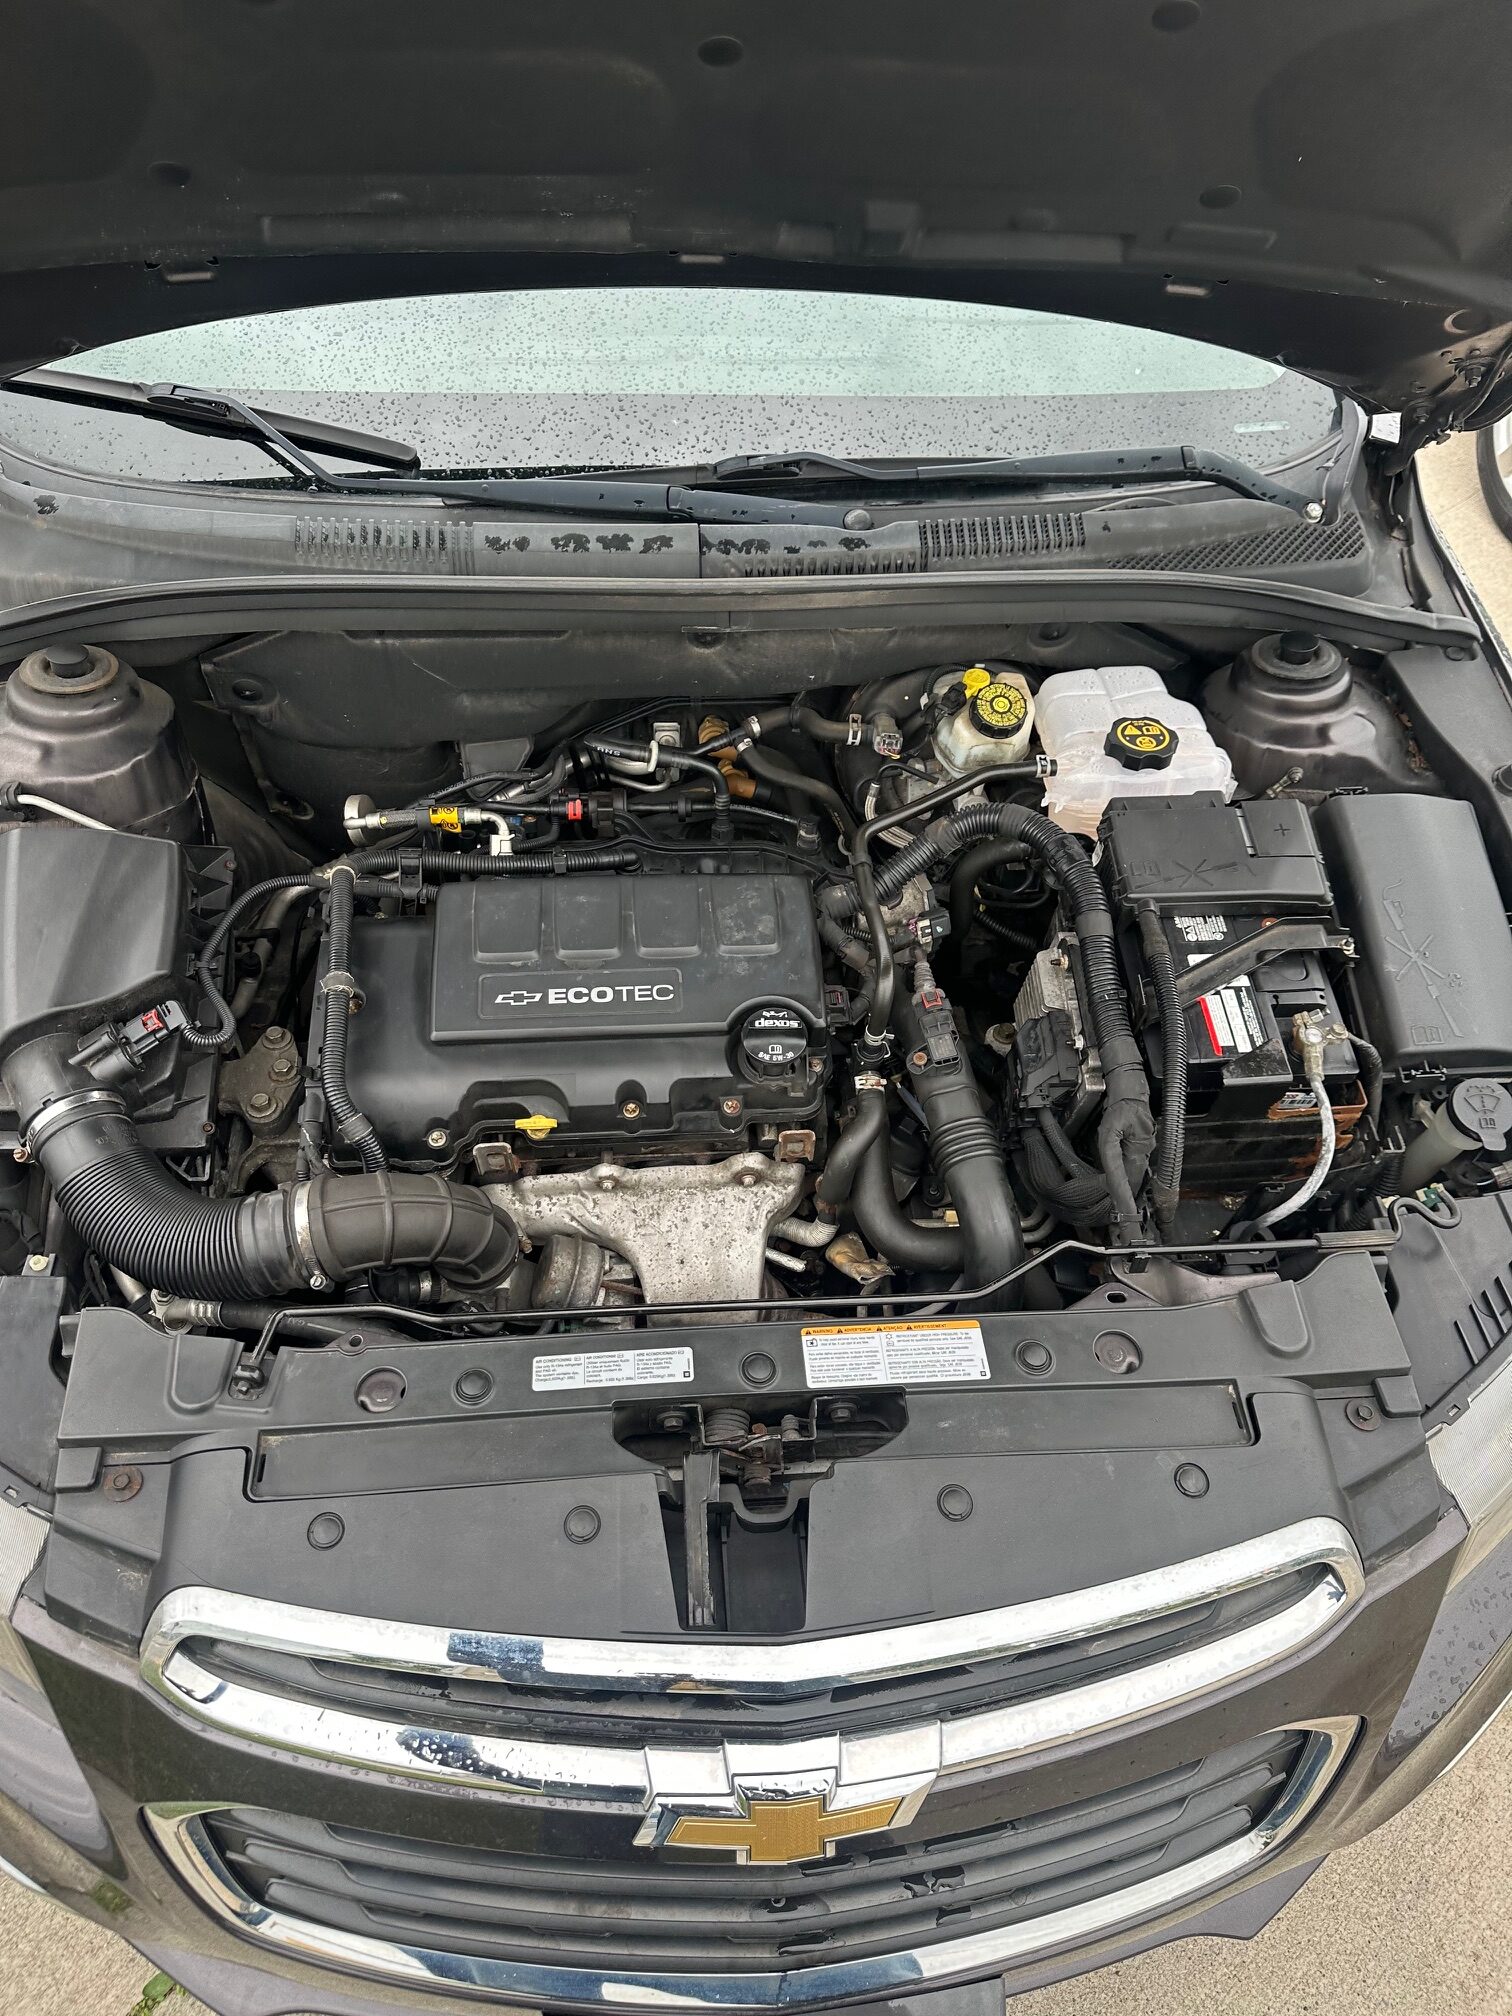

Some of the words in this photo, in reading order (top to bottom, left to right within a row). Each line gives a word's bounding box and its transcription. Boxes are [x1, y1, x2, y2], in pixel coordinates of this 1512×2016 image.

[548, 984, 674, 1004] ECOTEC
[754, 1018, 800, 1028] dexos
[758, 1052, 770, 1061] SAE
